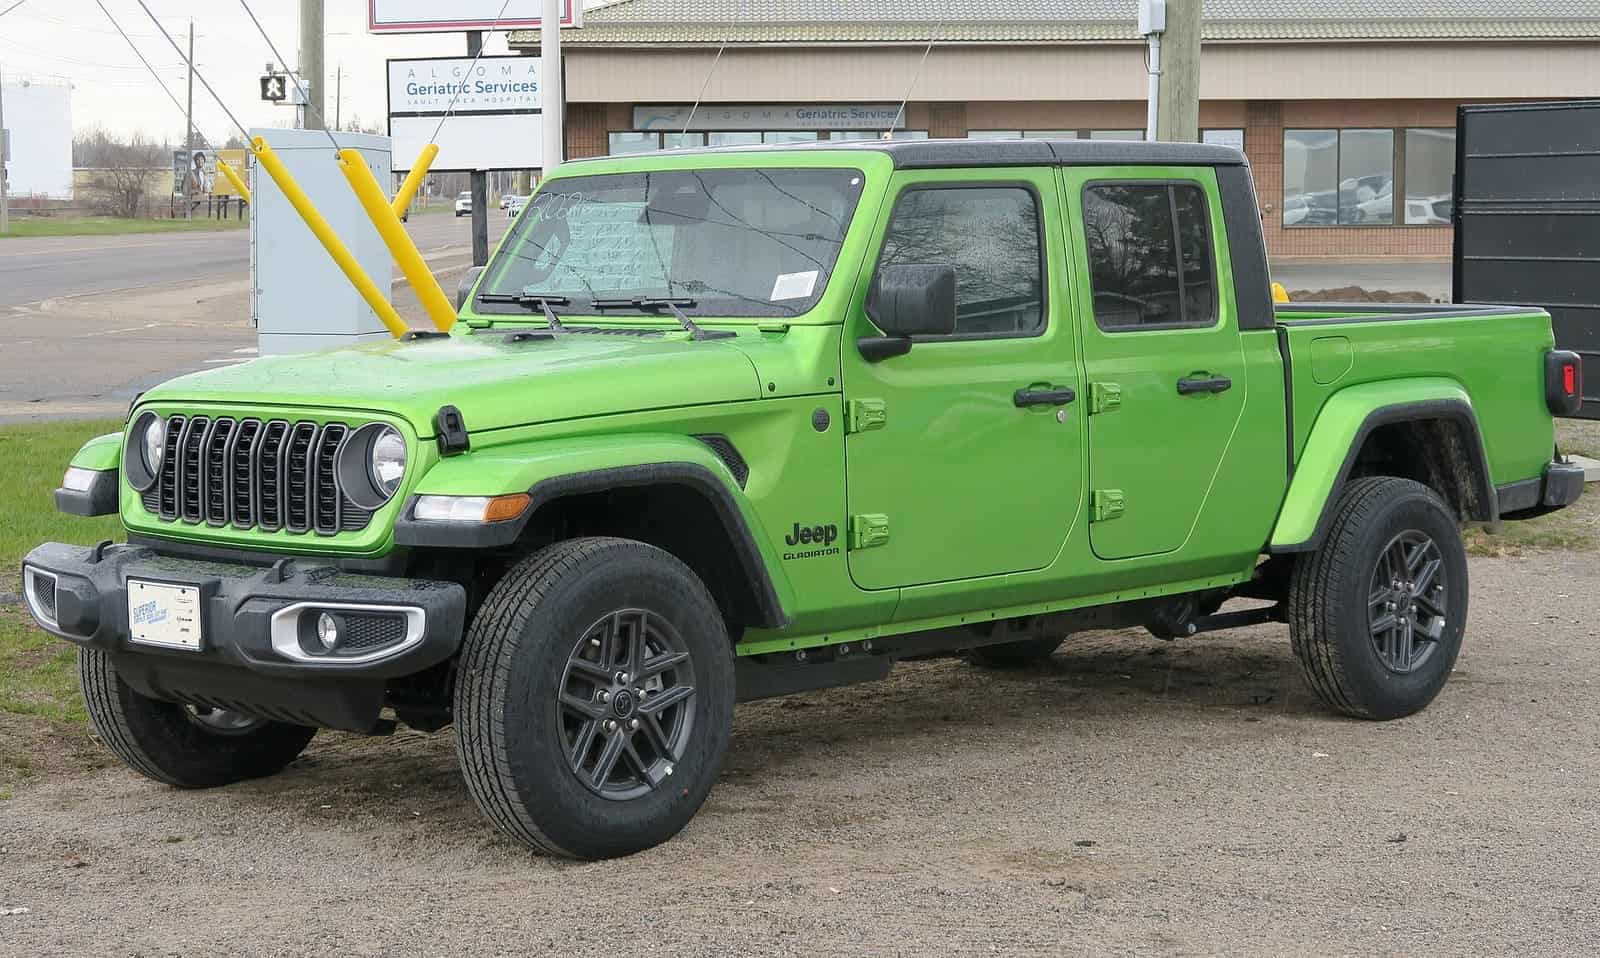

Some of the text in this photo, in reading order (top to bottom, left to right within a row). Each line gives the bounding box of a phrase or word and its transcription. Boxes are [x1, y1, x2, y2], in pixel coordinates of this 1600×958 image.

[406, 80, 538, 96] Geriatric Services
[796, 108, 847, 119] Geriatric
[785, 522, 838, 547] Jeep
[783, 547, 840, 560] GLADIATOR
